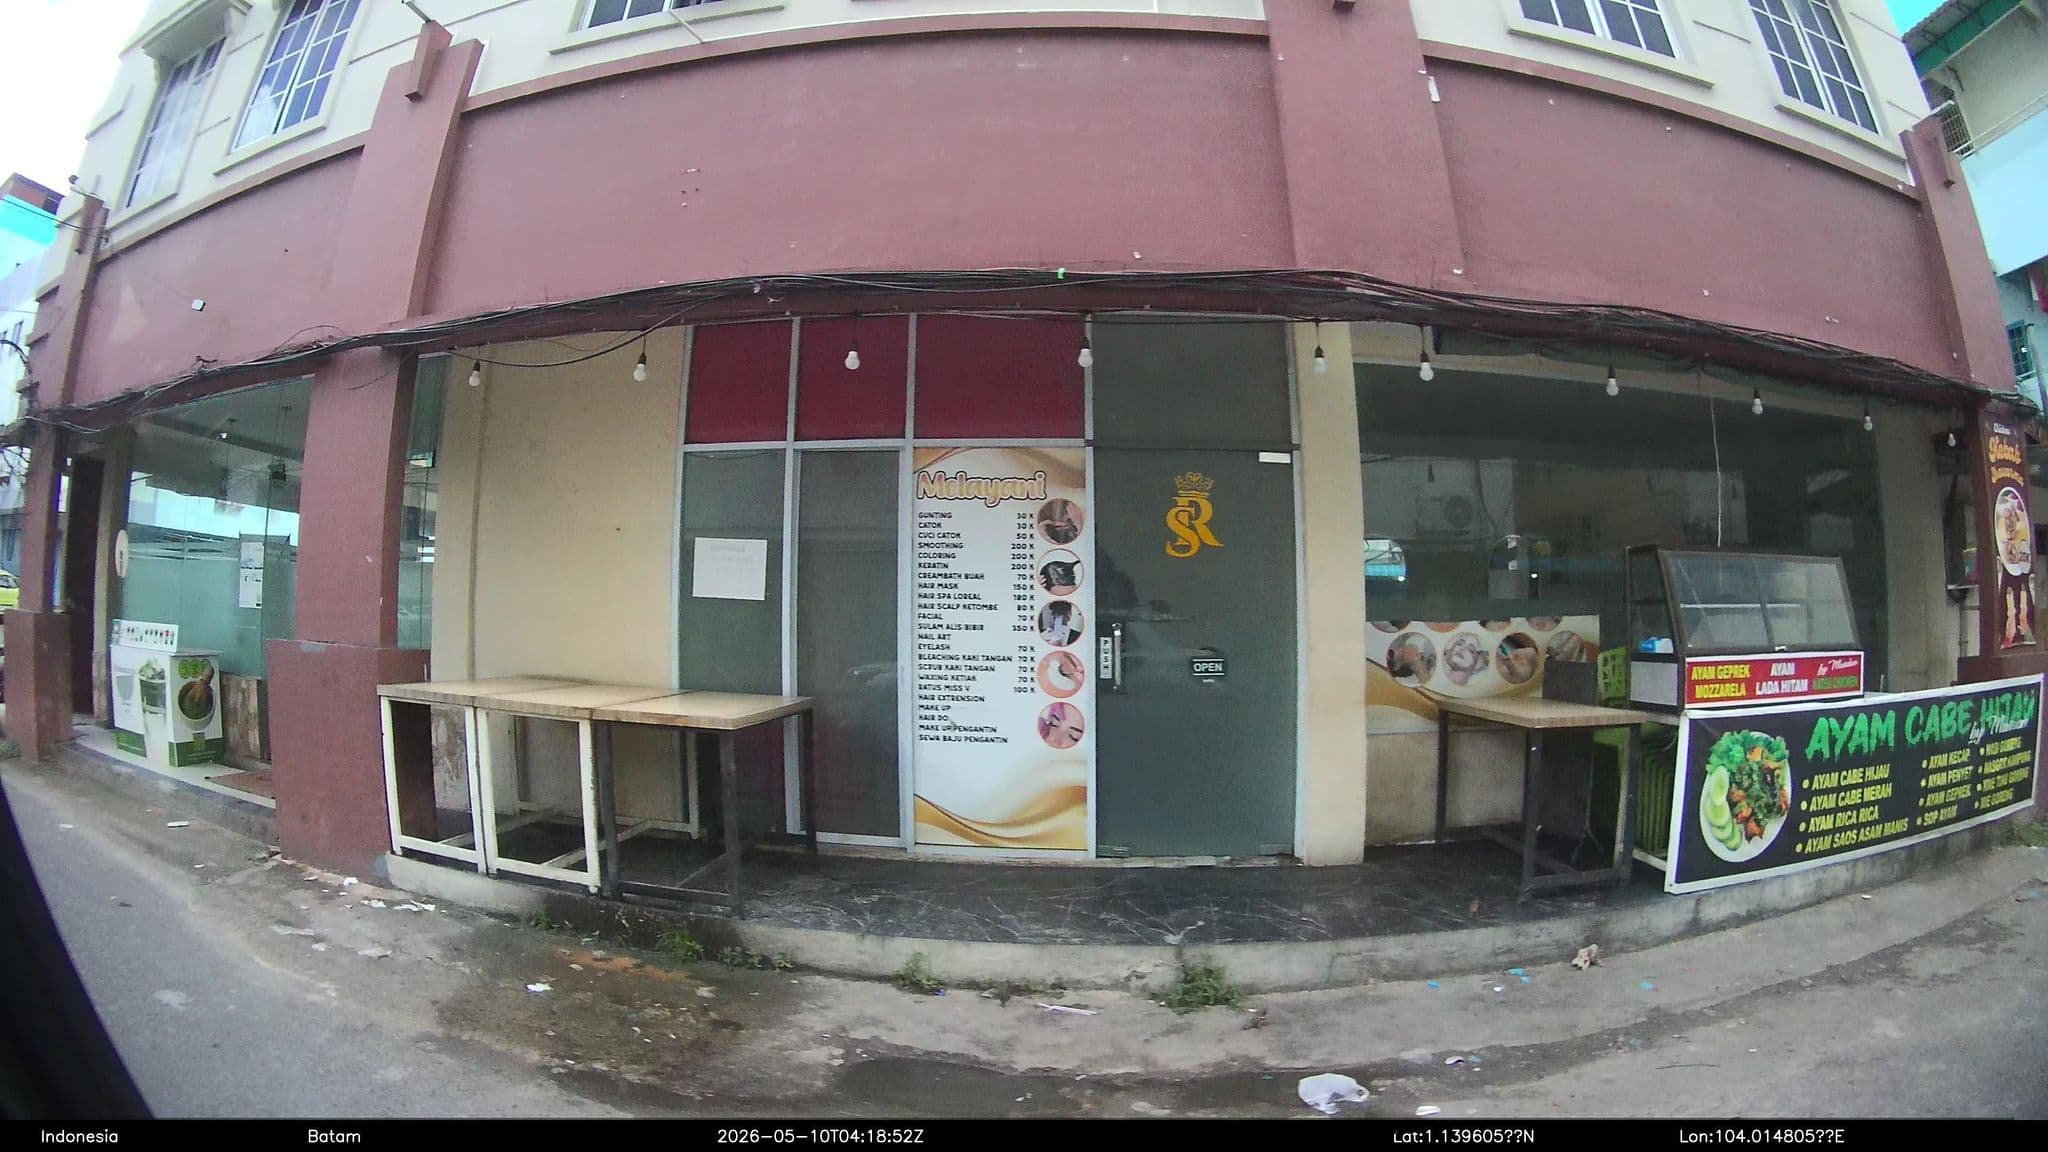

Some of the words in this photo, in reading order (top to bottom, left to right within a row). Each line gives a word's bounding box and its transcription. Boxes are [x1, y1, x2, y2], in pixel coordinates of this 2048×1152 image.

[916, 471, 1047, 508] Melayani
[1193, 662, 1222, 672] OPEN
[1692, 666, 1715, 680] AYAM
[1717, 664, 1750, 680] GEPREK
[1770, 662, 1796, 677] AYAM
[1756, 680, 1780, 696] LADA
[1781, 678, 1808, 694] HITAM
[1804, 710, 1896, 762] AYAM
[1904, 699, 1973, 746] CABE
[1812, 772, 1839, 790] AYAM
[1840, 768, 1864, 786] CABE
[1865, 764, 1890, 782] HIJAU
[1810, 792, 1836, 812] AYAM
[1838, 788, 1862, 807] CABE
[1863, 782, 1892, 802] MERAH
[1808, 814, 1834, 833] AYAM
[1836, 810, 1856, 828] RICA
[1859, 805, 1879, 823] RICA
[1805, 834, 1832, 854] AYAM
[1833, 829, 1858, 848] SAOS
[1858, 824, 1883, 842] ASAM
